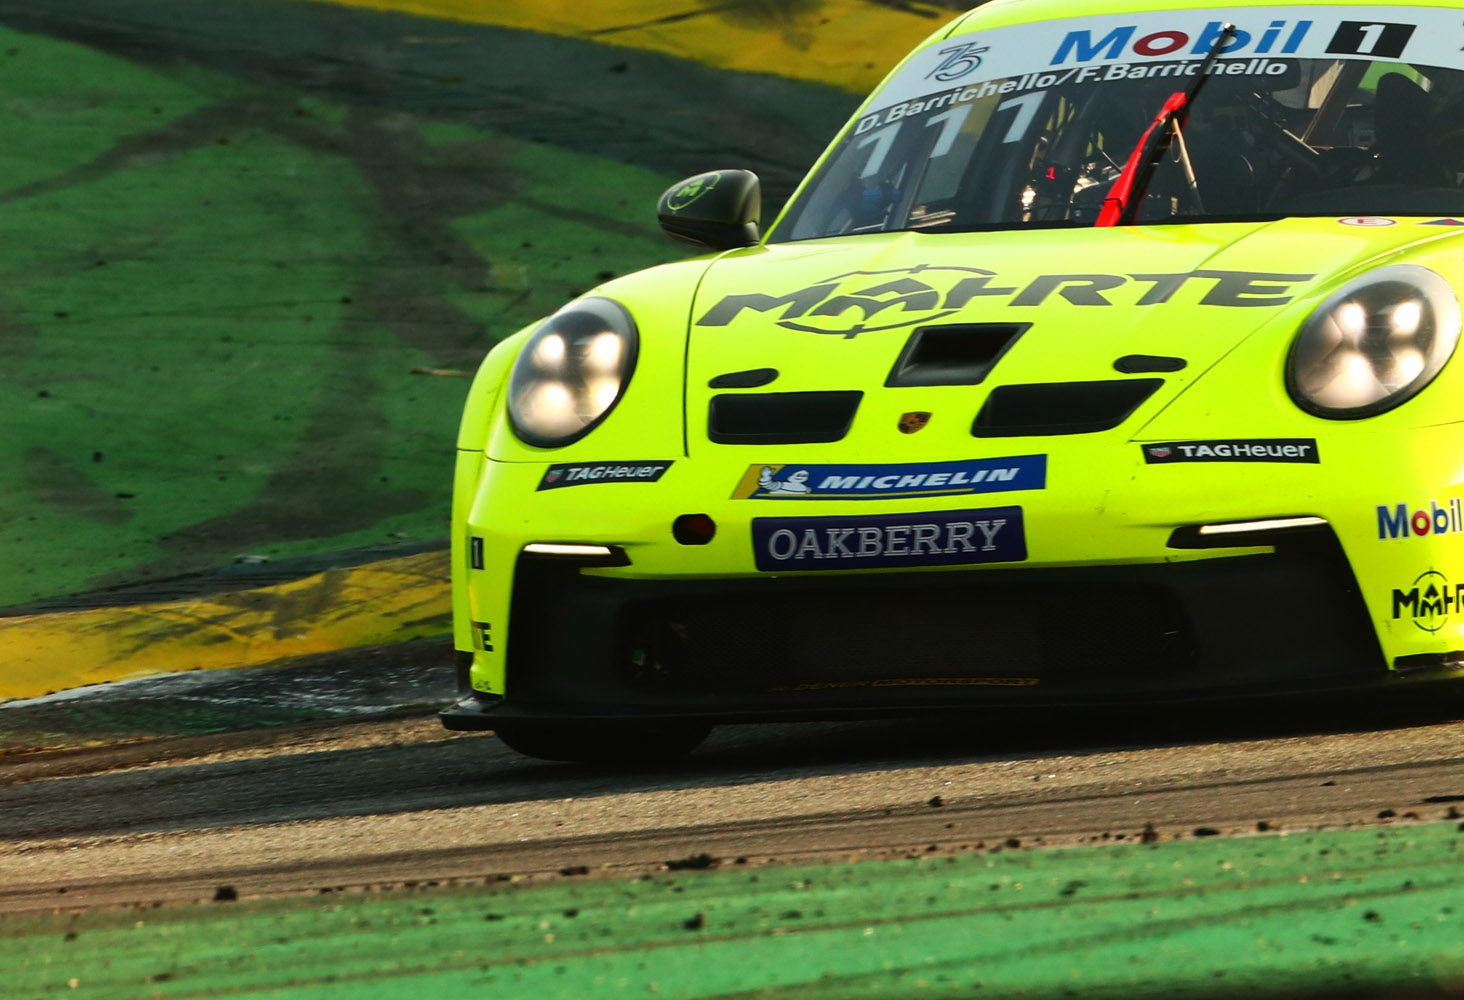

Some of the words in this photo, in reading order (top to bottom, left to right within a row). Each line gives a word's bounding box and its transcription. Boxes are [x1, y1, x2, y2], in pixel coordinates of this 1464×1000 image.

[923, 41, 991, 82] 75
[1049, 20, 1313, 66] Mobil
[857, 90, 1048, 180] 111
[1178, 443, 1312, 459] TAGHeuer
[566, 463, 664, 482] TAGHeuer
[817, 466, 1020, 490] MICHELIN
[1377, 497, 1463, 540] Mobil
[767, 519, 1007, 561] OAKBERRY
